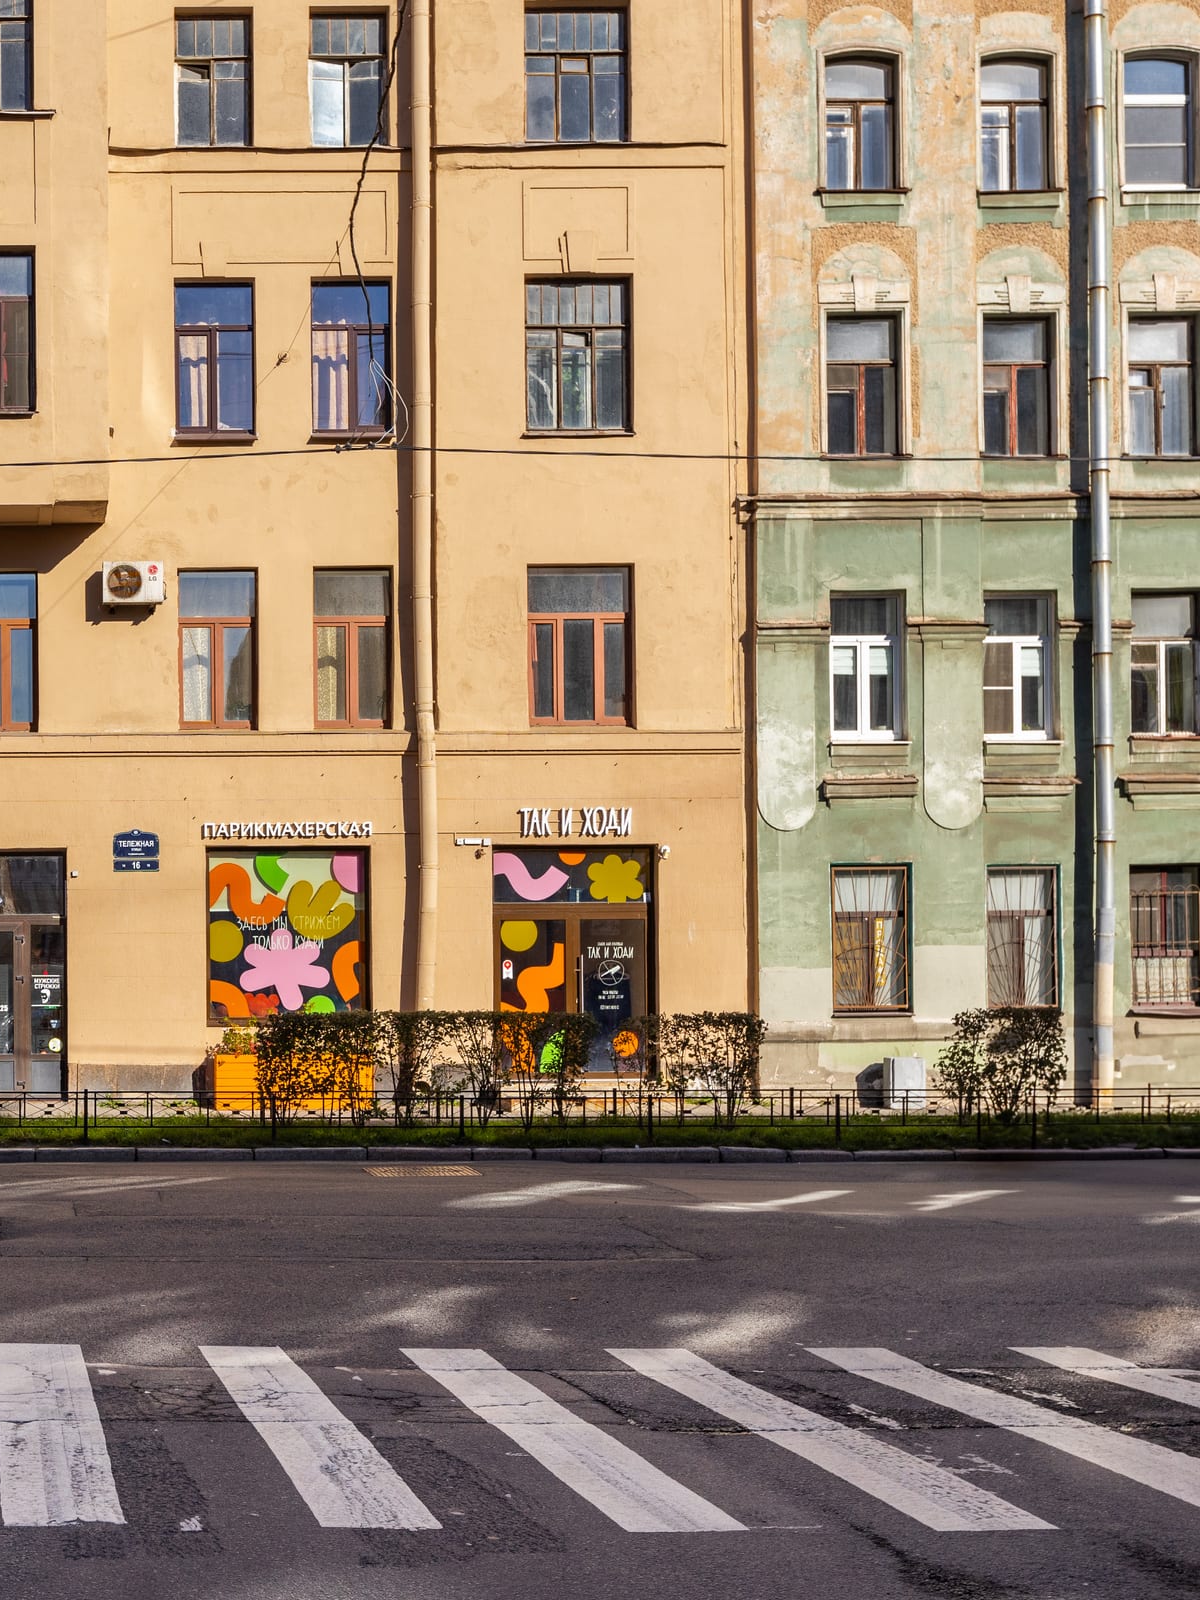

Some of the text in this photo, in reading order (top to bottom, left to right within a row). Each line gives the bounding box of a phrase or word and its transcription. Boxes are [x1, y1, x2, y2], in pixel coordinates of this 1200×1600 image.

[202, 821, 374, 838] ПАРИКМАХЕРСКАЯ
[519, 806, 633, 837] ТАК И ХОДИ
[117, 840, 155, 848] ТЕЛЕЖНАЯ
[132, 861, 141, 869] 16
[236, 915, 268, 931] ЗДЕСЬ
[272, 916, 288, 931] МЫ
[252, 935, 325, 951] ТОЛЬКО КУДРИ
[587, 946, 634, 959] ТАК И ХОДИ
